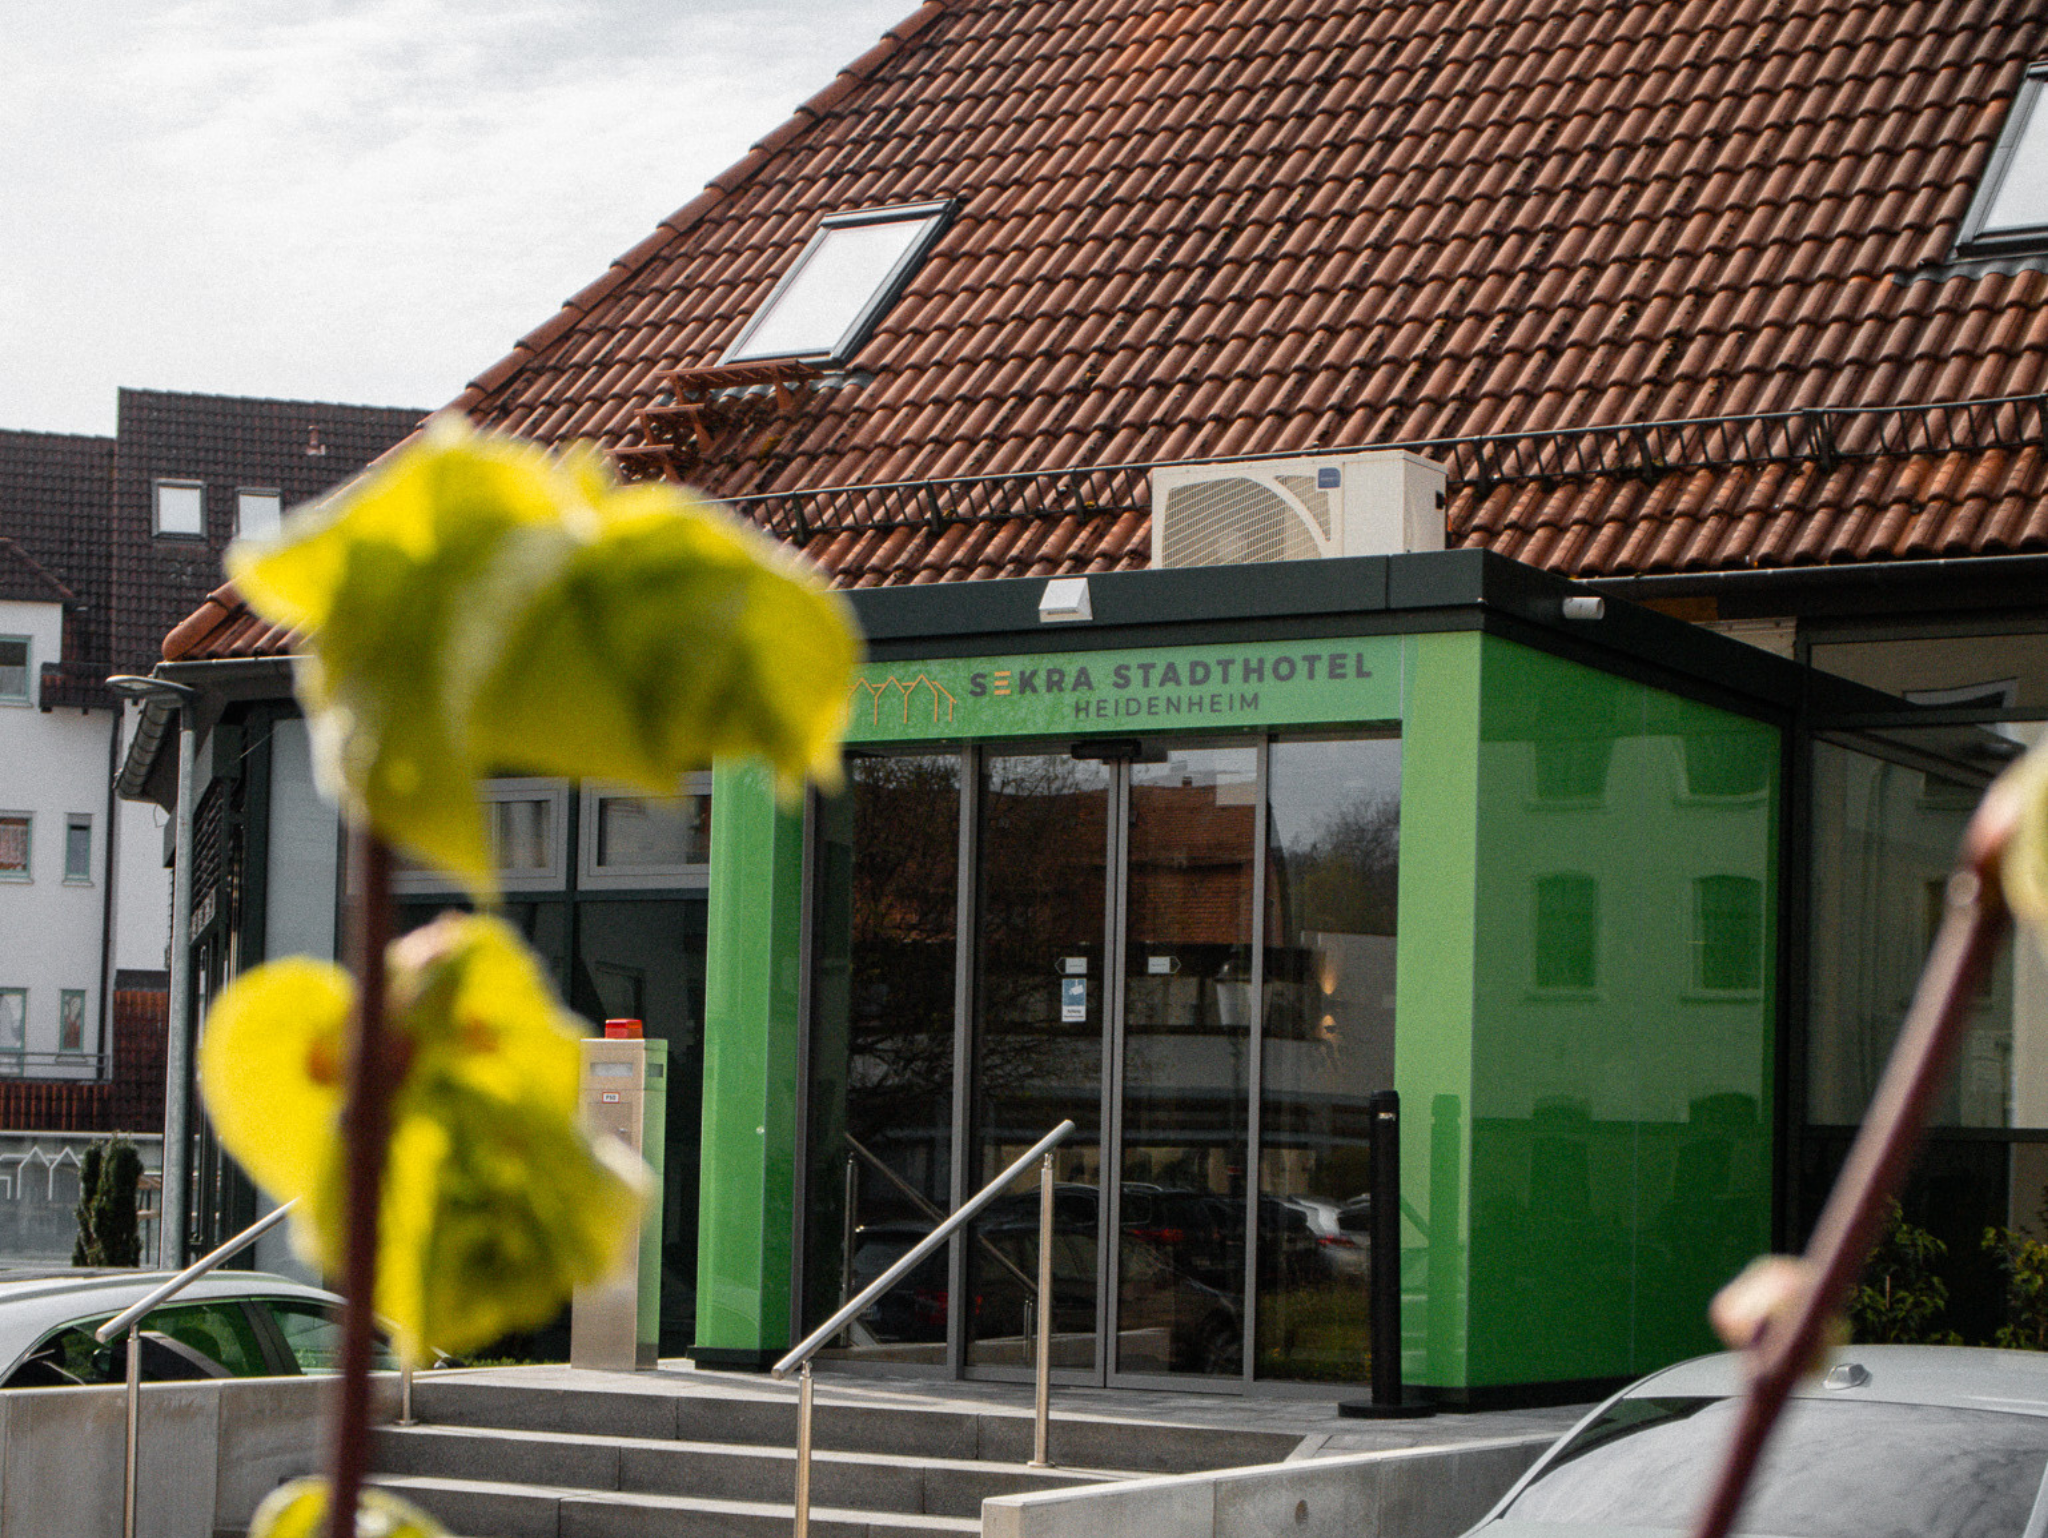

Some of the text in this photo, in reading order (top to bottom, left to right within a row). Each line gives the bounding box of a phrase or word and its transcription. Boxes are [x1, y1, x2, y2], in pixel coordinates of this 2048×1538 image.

[969, 652, 1373, 697] SEKRA STADTHOTEL
[1074, 692, 1259, 719] HEIDENHEIM
